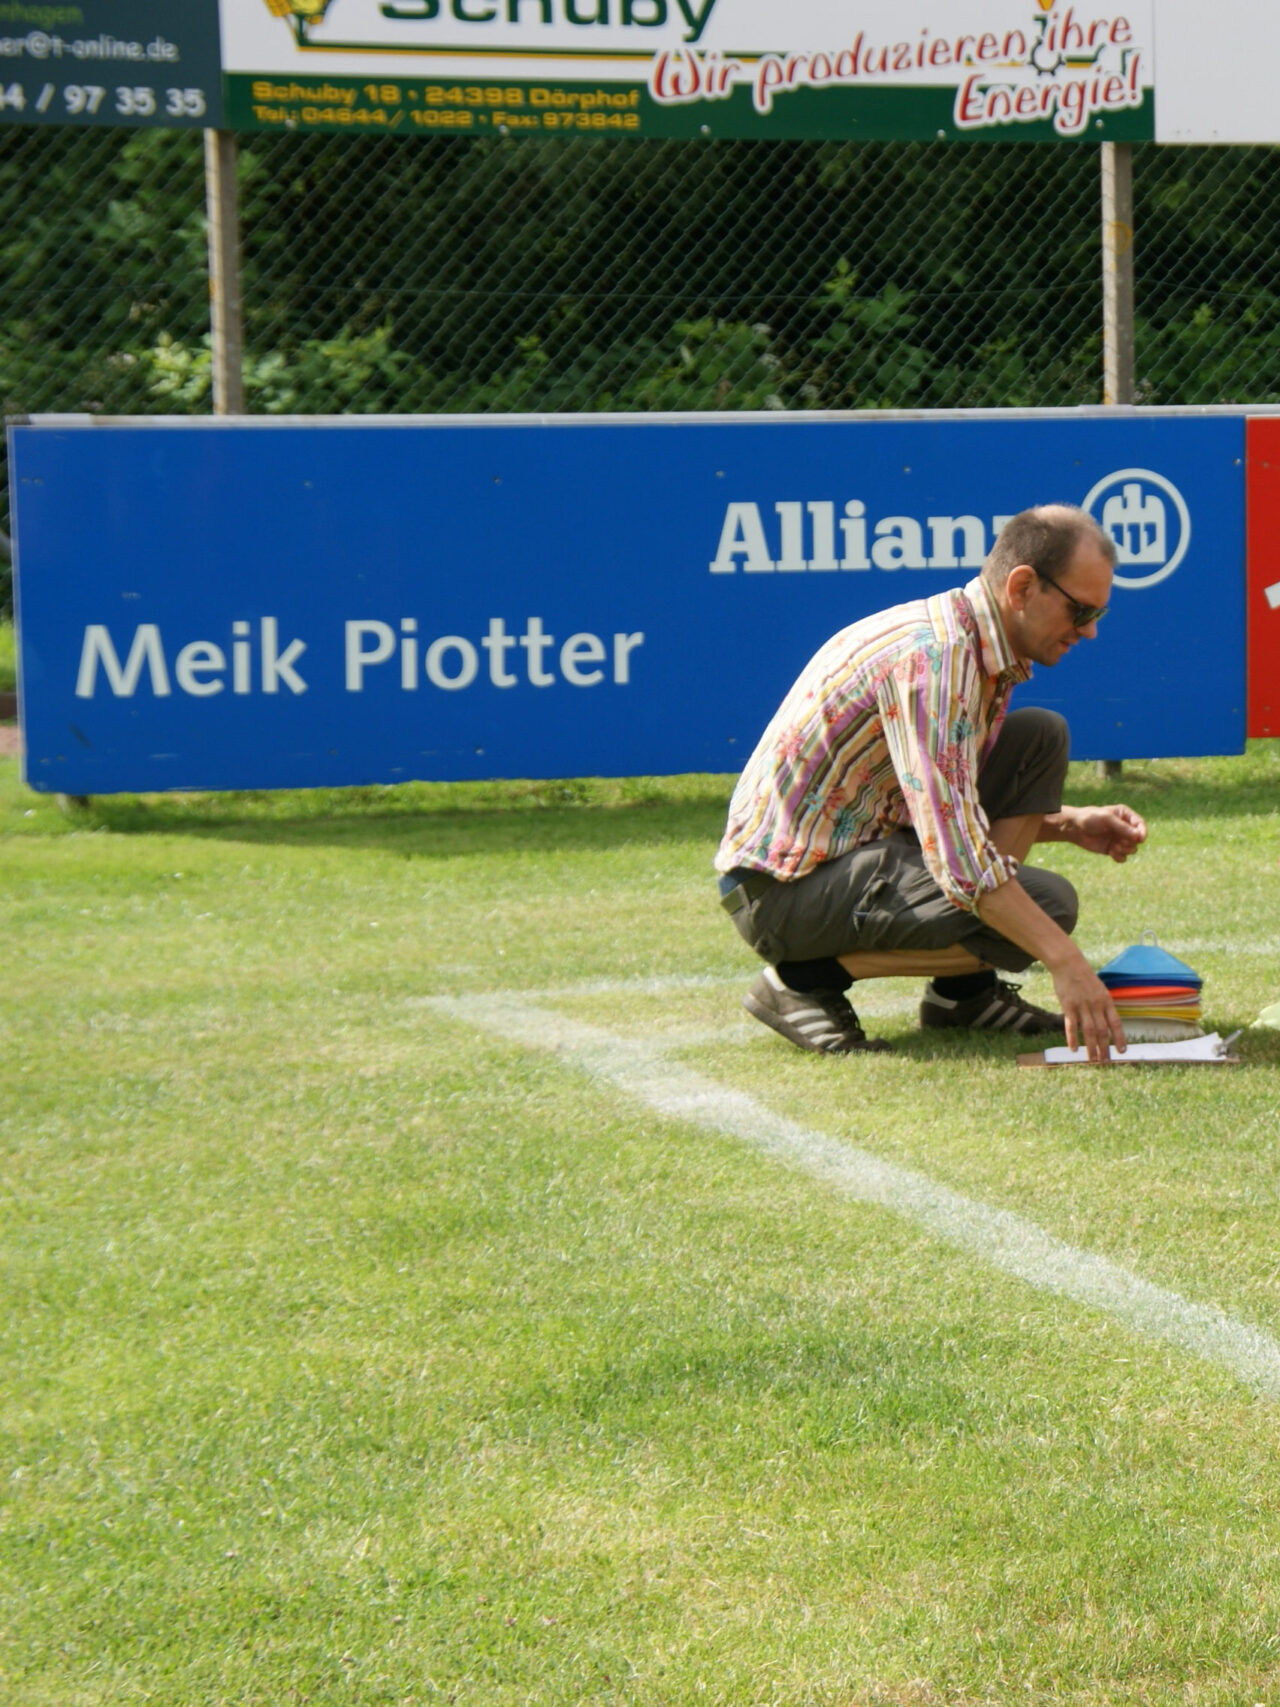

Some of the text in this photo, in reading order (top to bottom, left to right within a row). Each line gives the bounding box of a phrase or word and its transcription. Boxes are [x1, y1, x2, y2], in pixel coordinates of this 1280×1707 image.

[0, 31, 180, 62] er@t-online.de
[653, 6, 1132, 107] Wir produzieren ihre
[0, 83, 25, 111] 4
[63, 85, 105, 114] 97
[115, 86, 156, 116] 35
[166, 88, 206, 117] 35
[252, 81, 640, 111] Schuby 18 24398 Dörphof
[957, 52, 1141, 129] Energie!
[543, 111, 640, 130] 973842
[708, 498, 1016, 575] Allian
[75, 616, 645, 698] Meik Piotter
